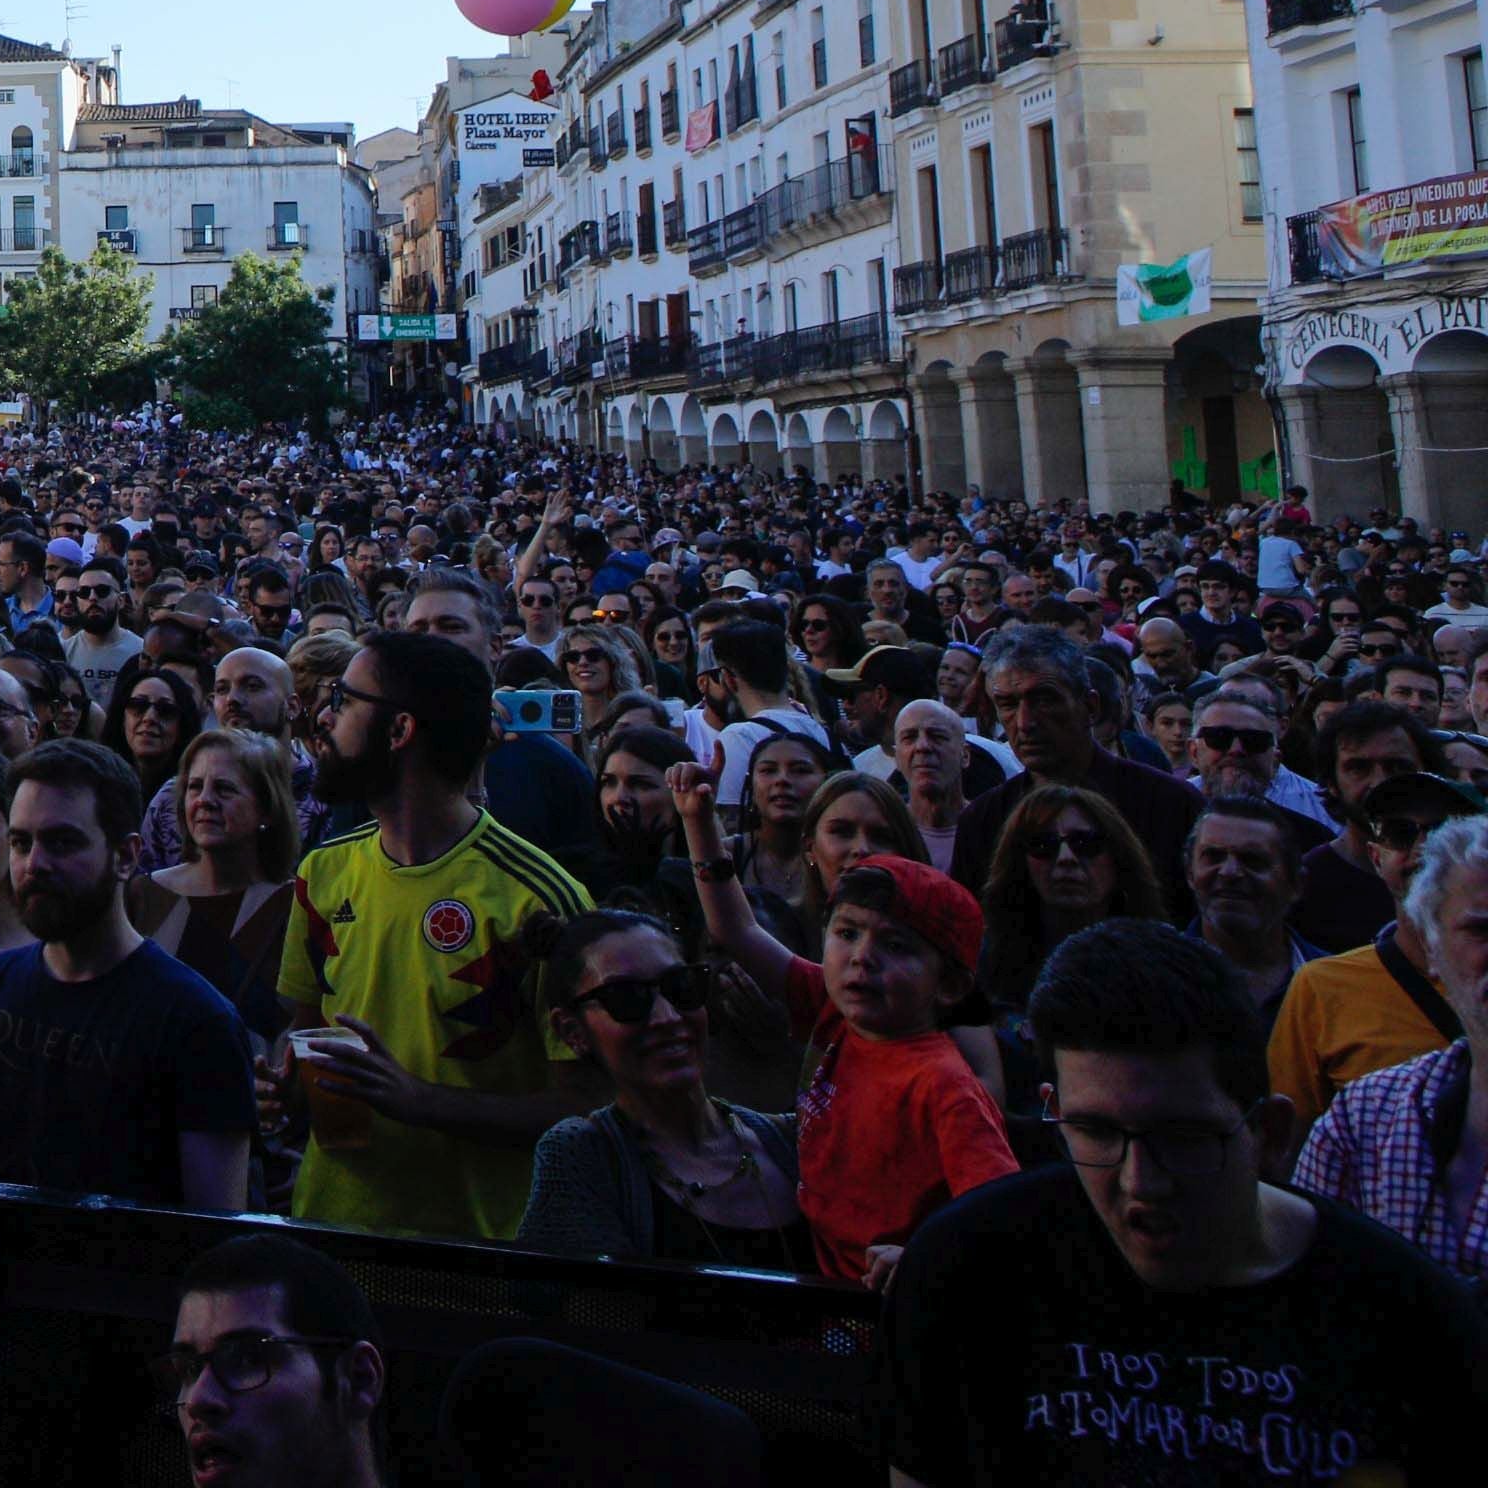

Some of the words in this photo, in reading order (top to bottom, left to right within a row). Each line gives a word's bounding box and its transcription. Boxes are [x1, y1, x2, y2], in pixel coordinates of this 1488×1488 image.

[464, 113, 513, 126] HOTEL
[465, 128, 501, 139] Plaza
[503, 127, 546, 141] Mayor
[1423, 208, 1437, 226] DE
[1439, 206, 1453, 224] LA
[1455, 202, 1488, 223] POBLA
[111, 232, 120, 240] SE
[1438, 295, 1488, 330] PAT
[399, 319, 421, 327] SALIDA
[1258, 1410, 1360, 1479] CULO
